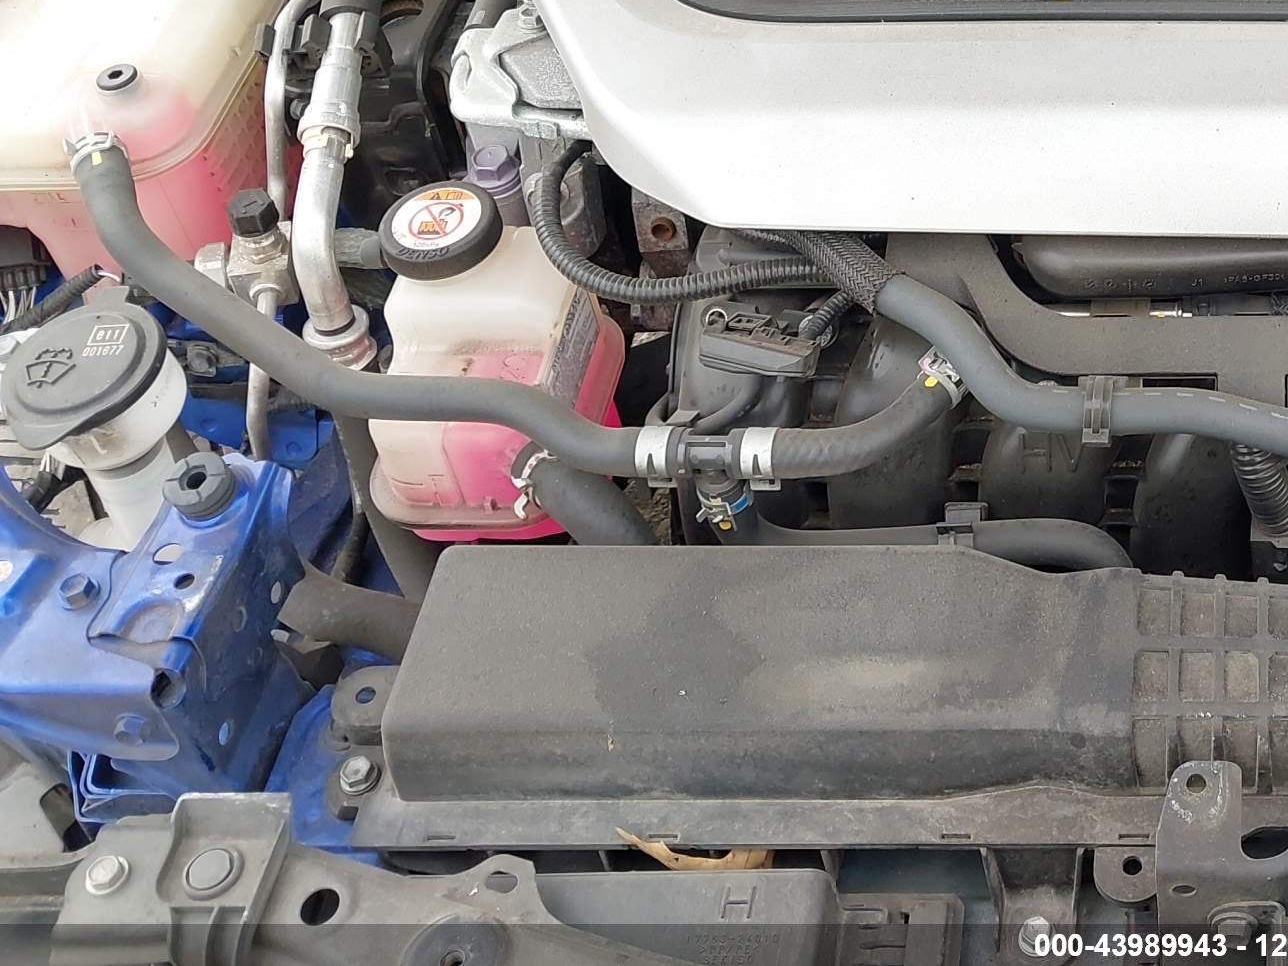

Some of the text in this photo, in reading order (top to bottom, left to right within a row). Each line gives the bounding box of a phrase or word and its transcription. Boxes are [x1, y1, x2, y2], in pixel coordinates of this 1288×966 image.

[398, 246, 449, 260] DENSO
[82, 344, 124, 357] 001677
[720, 885, 757, 920] H
